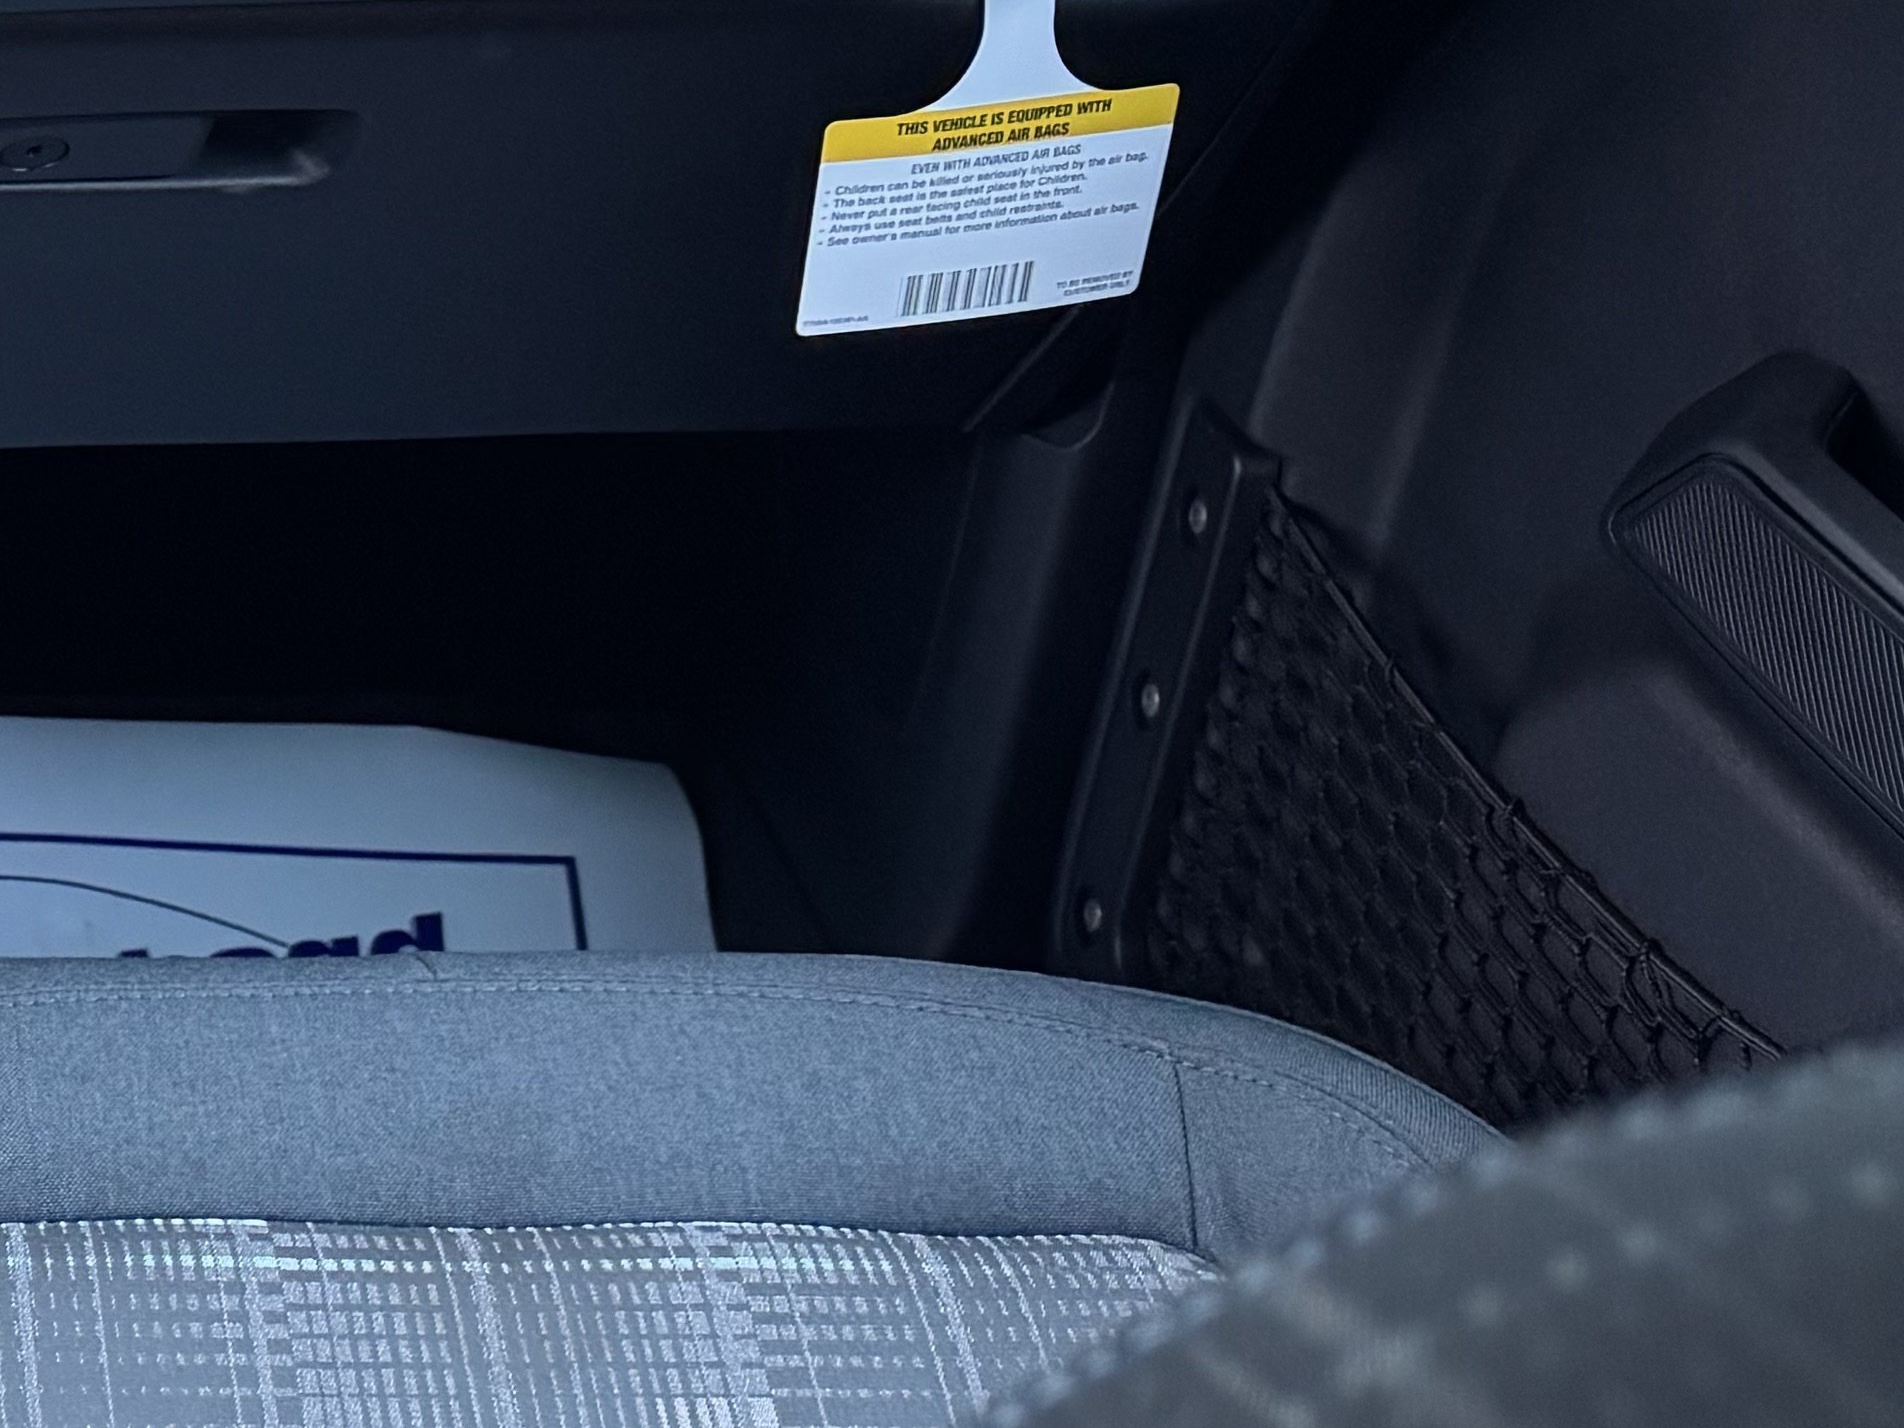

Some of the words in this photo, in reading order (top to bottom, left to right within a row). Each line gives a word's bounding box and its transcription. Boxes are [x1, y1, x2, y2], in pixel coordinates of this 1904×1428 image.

[897, 121, 928, 136] THIS
[933, 113, 988, 133] VEHICLE
[991, 112, 1004, 126] IS
[1007, 103, 1073, 124] EQUIPPED
[1077, 98, 1112, 115] WITH
[932, 131, 1004, 151] ADVANCED
[1007, 127, 1030, 143] AIR
[1034, 122, 1070, 139] BAGS
[911, 161, 940, 175] EVEN
[943, 158, 971, 171] WITH
[973, 150, 1029, 168] ADVANCED
[1031, 147, 1050, 161] AIR
[1053, 144, 1081, 158] BAGS
[835, 183, 884, 196] Children
